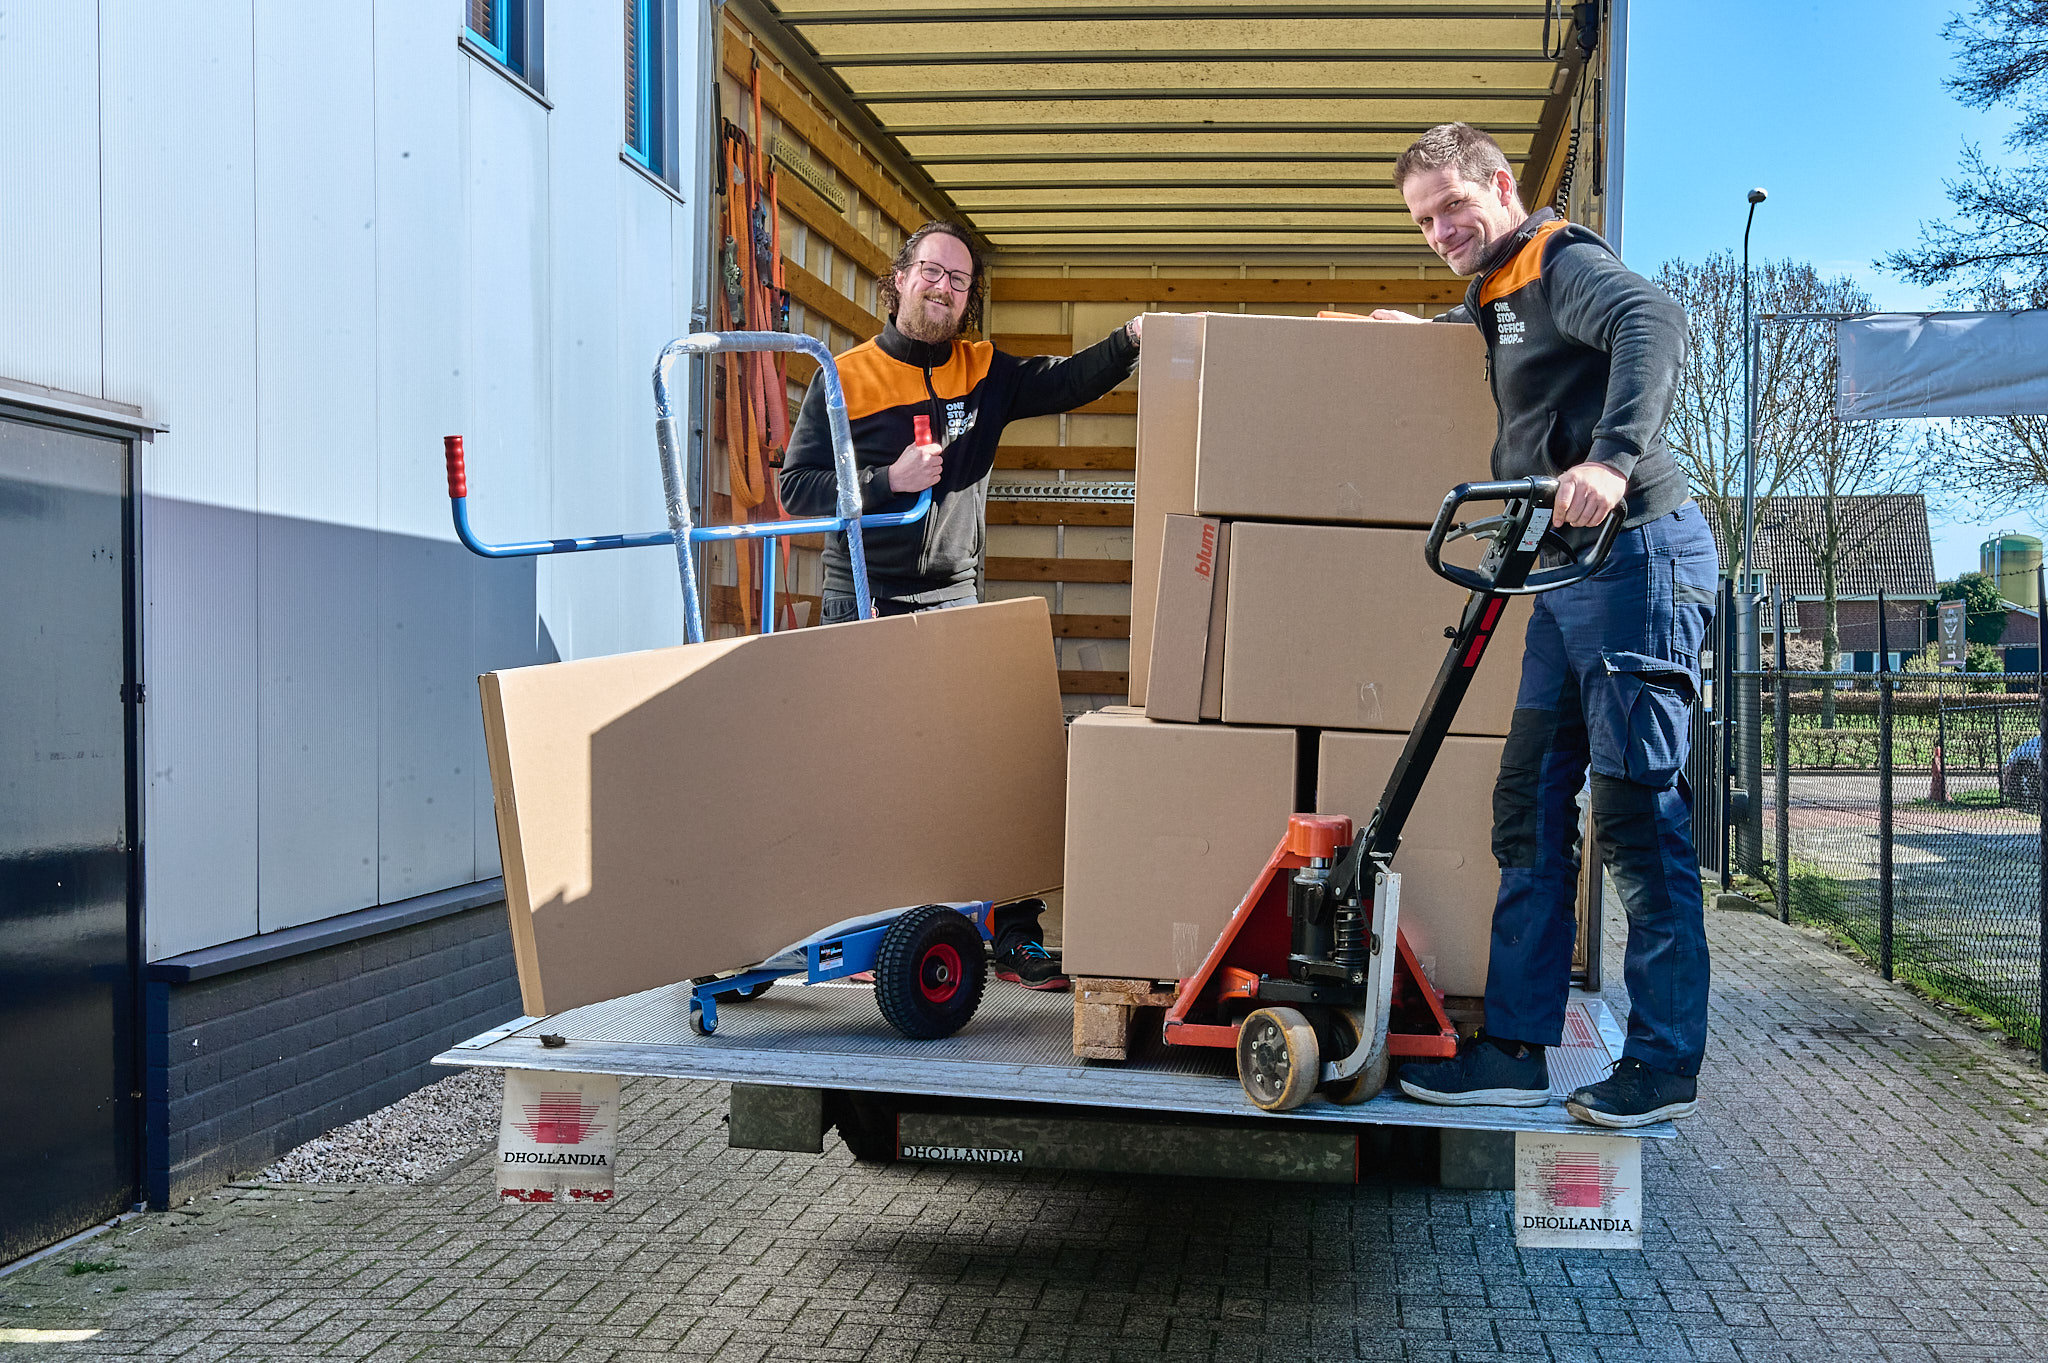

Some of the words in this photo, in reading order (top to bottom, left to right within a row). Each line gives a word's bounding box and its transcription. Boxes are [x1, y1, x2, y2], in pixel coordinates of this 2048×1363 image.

[1494, 302, 1511, 312] ONE
[1496, 312, 1516, 323] STOP
[1497, 321, 1526, 333] OFFICE
[1195, 523, 1215, 578] blum
[503, 1151, 608, 1166] DHOLLANDIA
[901, 1146, 1024, 1163] DHOLLANDIA
[1522, 1215, 1634, 1232] DHOLLANDIA
